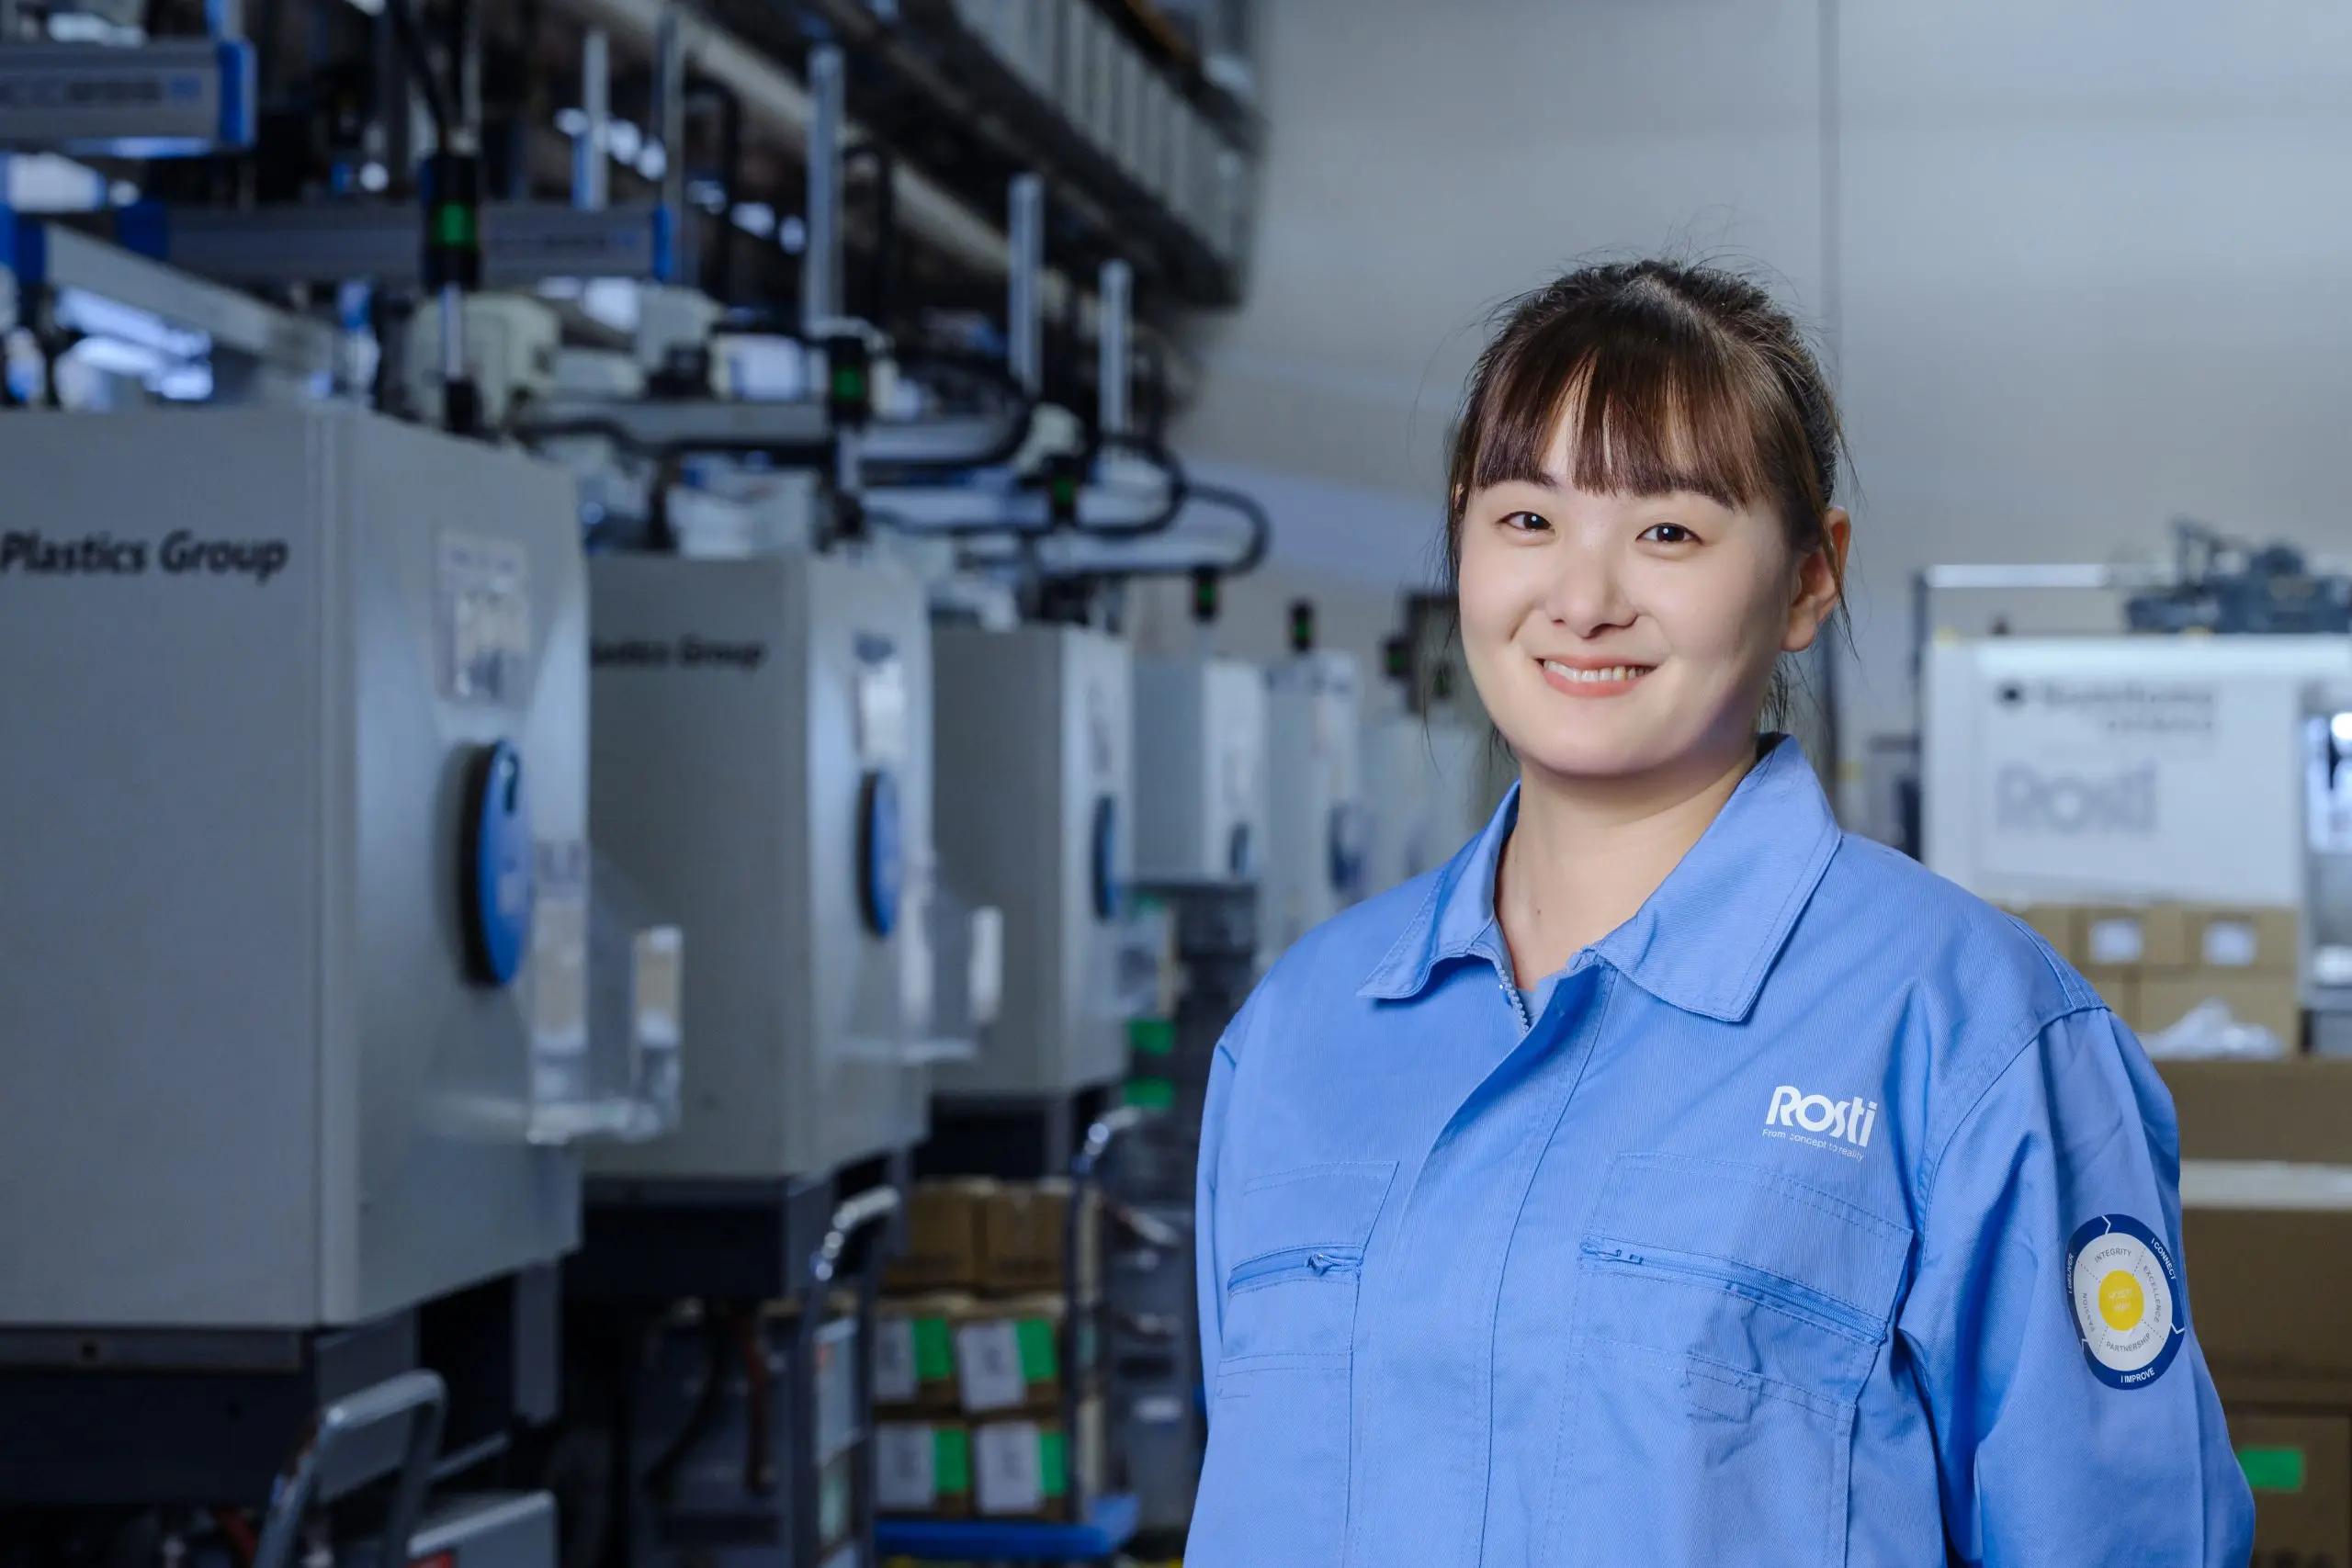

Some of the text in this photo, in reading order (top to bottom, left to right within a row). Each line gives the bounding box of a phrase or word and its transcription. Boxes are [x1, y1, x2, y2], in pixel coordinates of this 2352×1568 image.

[0, 528, 288, 585] Plastics Group
[1765, 1085, 1878, 1147] Rosti
[1762, 1129, 1864, 1162] From concept to reality
[2095, 1247, 2132, 1264] INTEGRITY
[2154, 1242, 2177, 1280] CONNECT
[2082, 1292, 2097, 1332] PASSION
[2143, 1265, 2161, 1324] EXCELLENCE
[2106, 1332, 2150, 1352] PARTNERSHIP
[2124, 1367, 2155, 1383] IMPROVE
